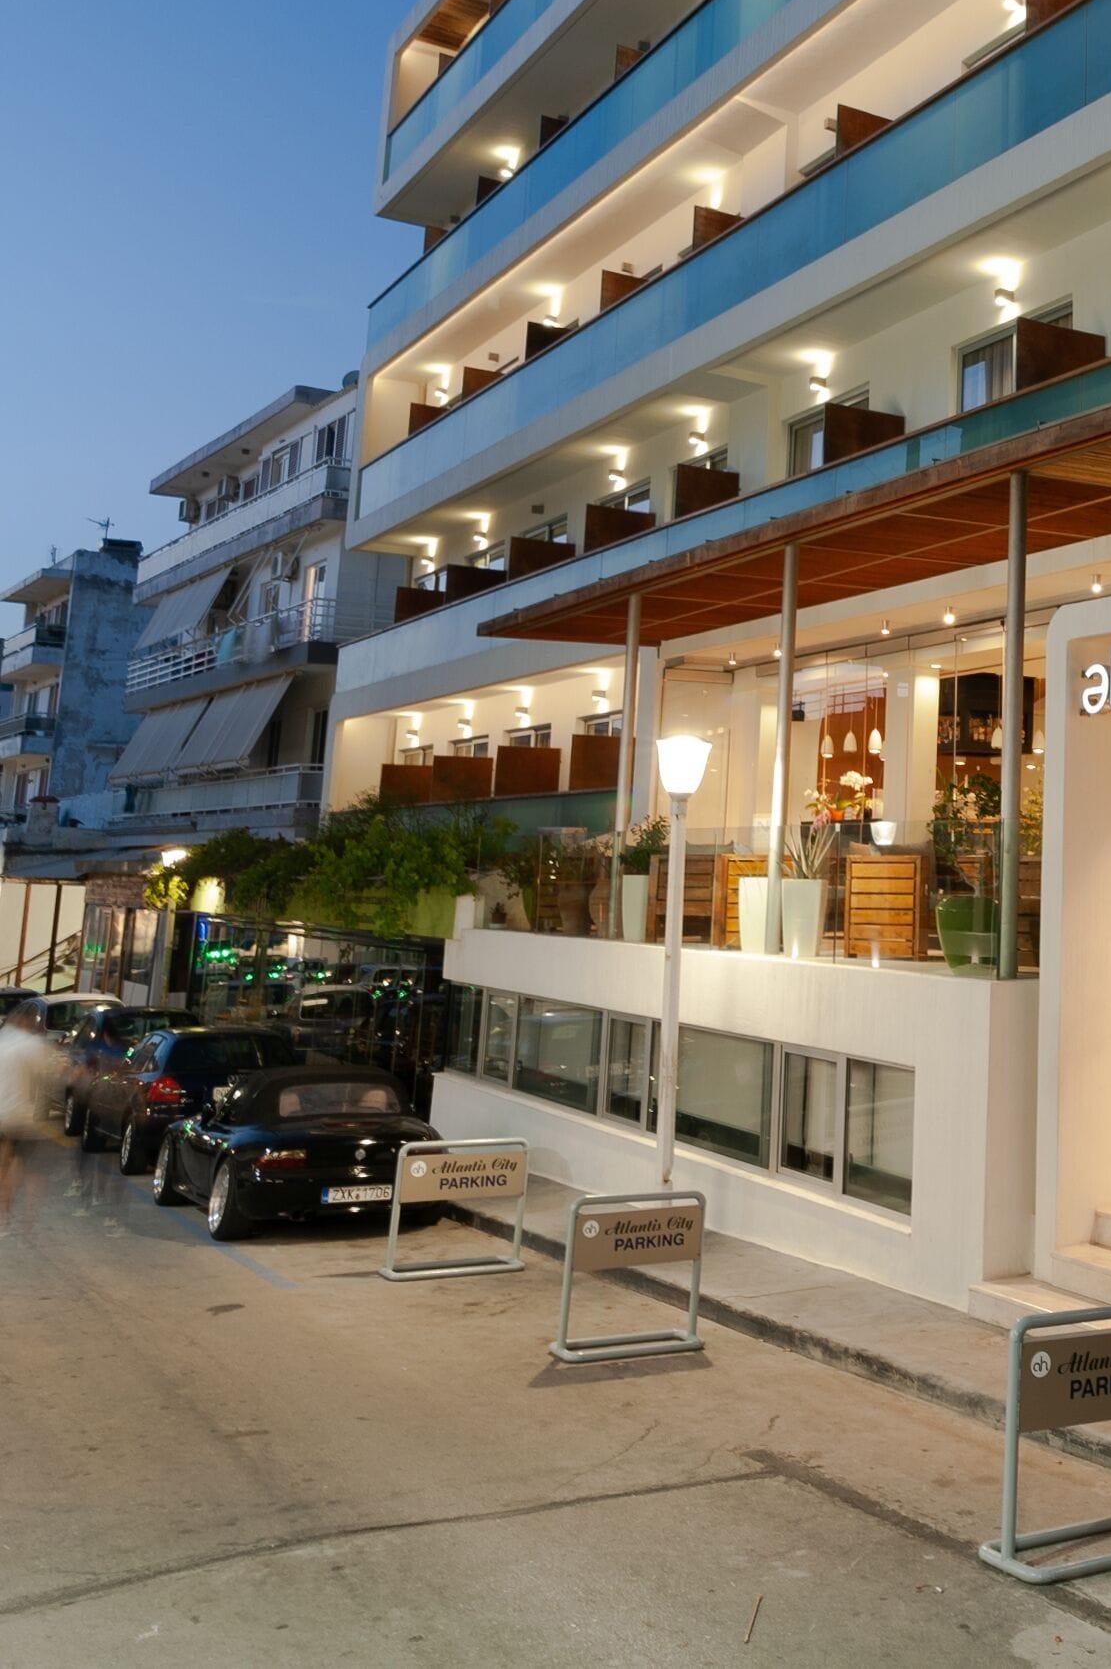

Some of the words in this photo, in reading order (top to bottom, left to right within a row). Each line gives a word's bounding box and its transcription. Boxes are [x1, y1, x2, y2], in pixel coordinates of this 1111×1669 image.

[431, 1160, 487, 1174] Atlantis
[492, 1158, 518, 1171] City
[439, 1174, 508, 1191] PARKING
[604, 1218, 662, 1236] Atlantis
[667, 1216, 695, 1231] City
[614, 1232, 685, 1252] PARKING
